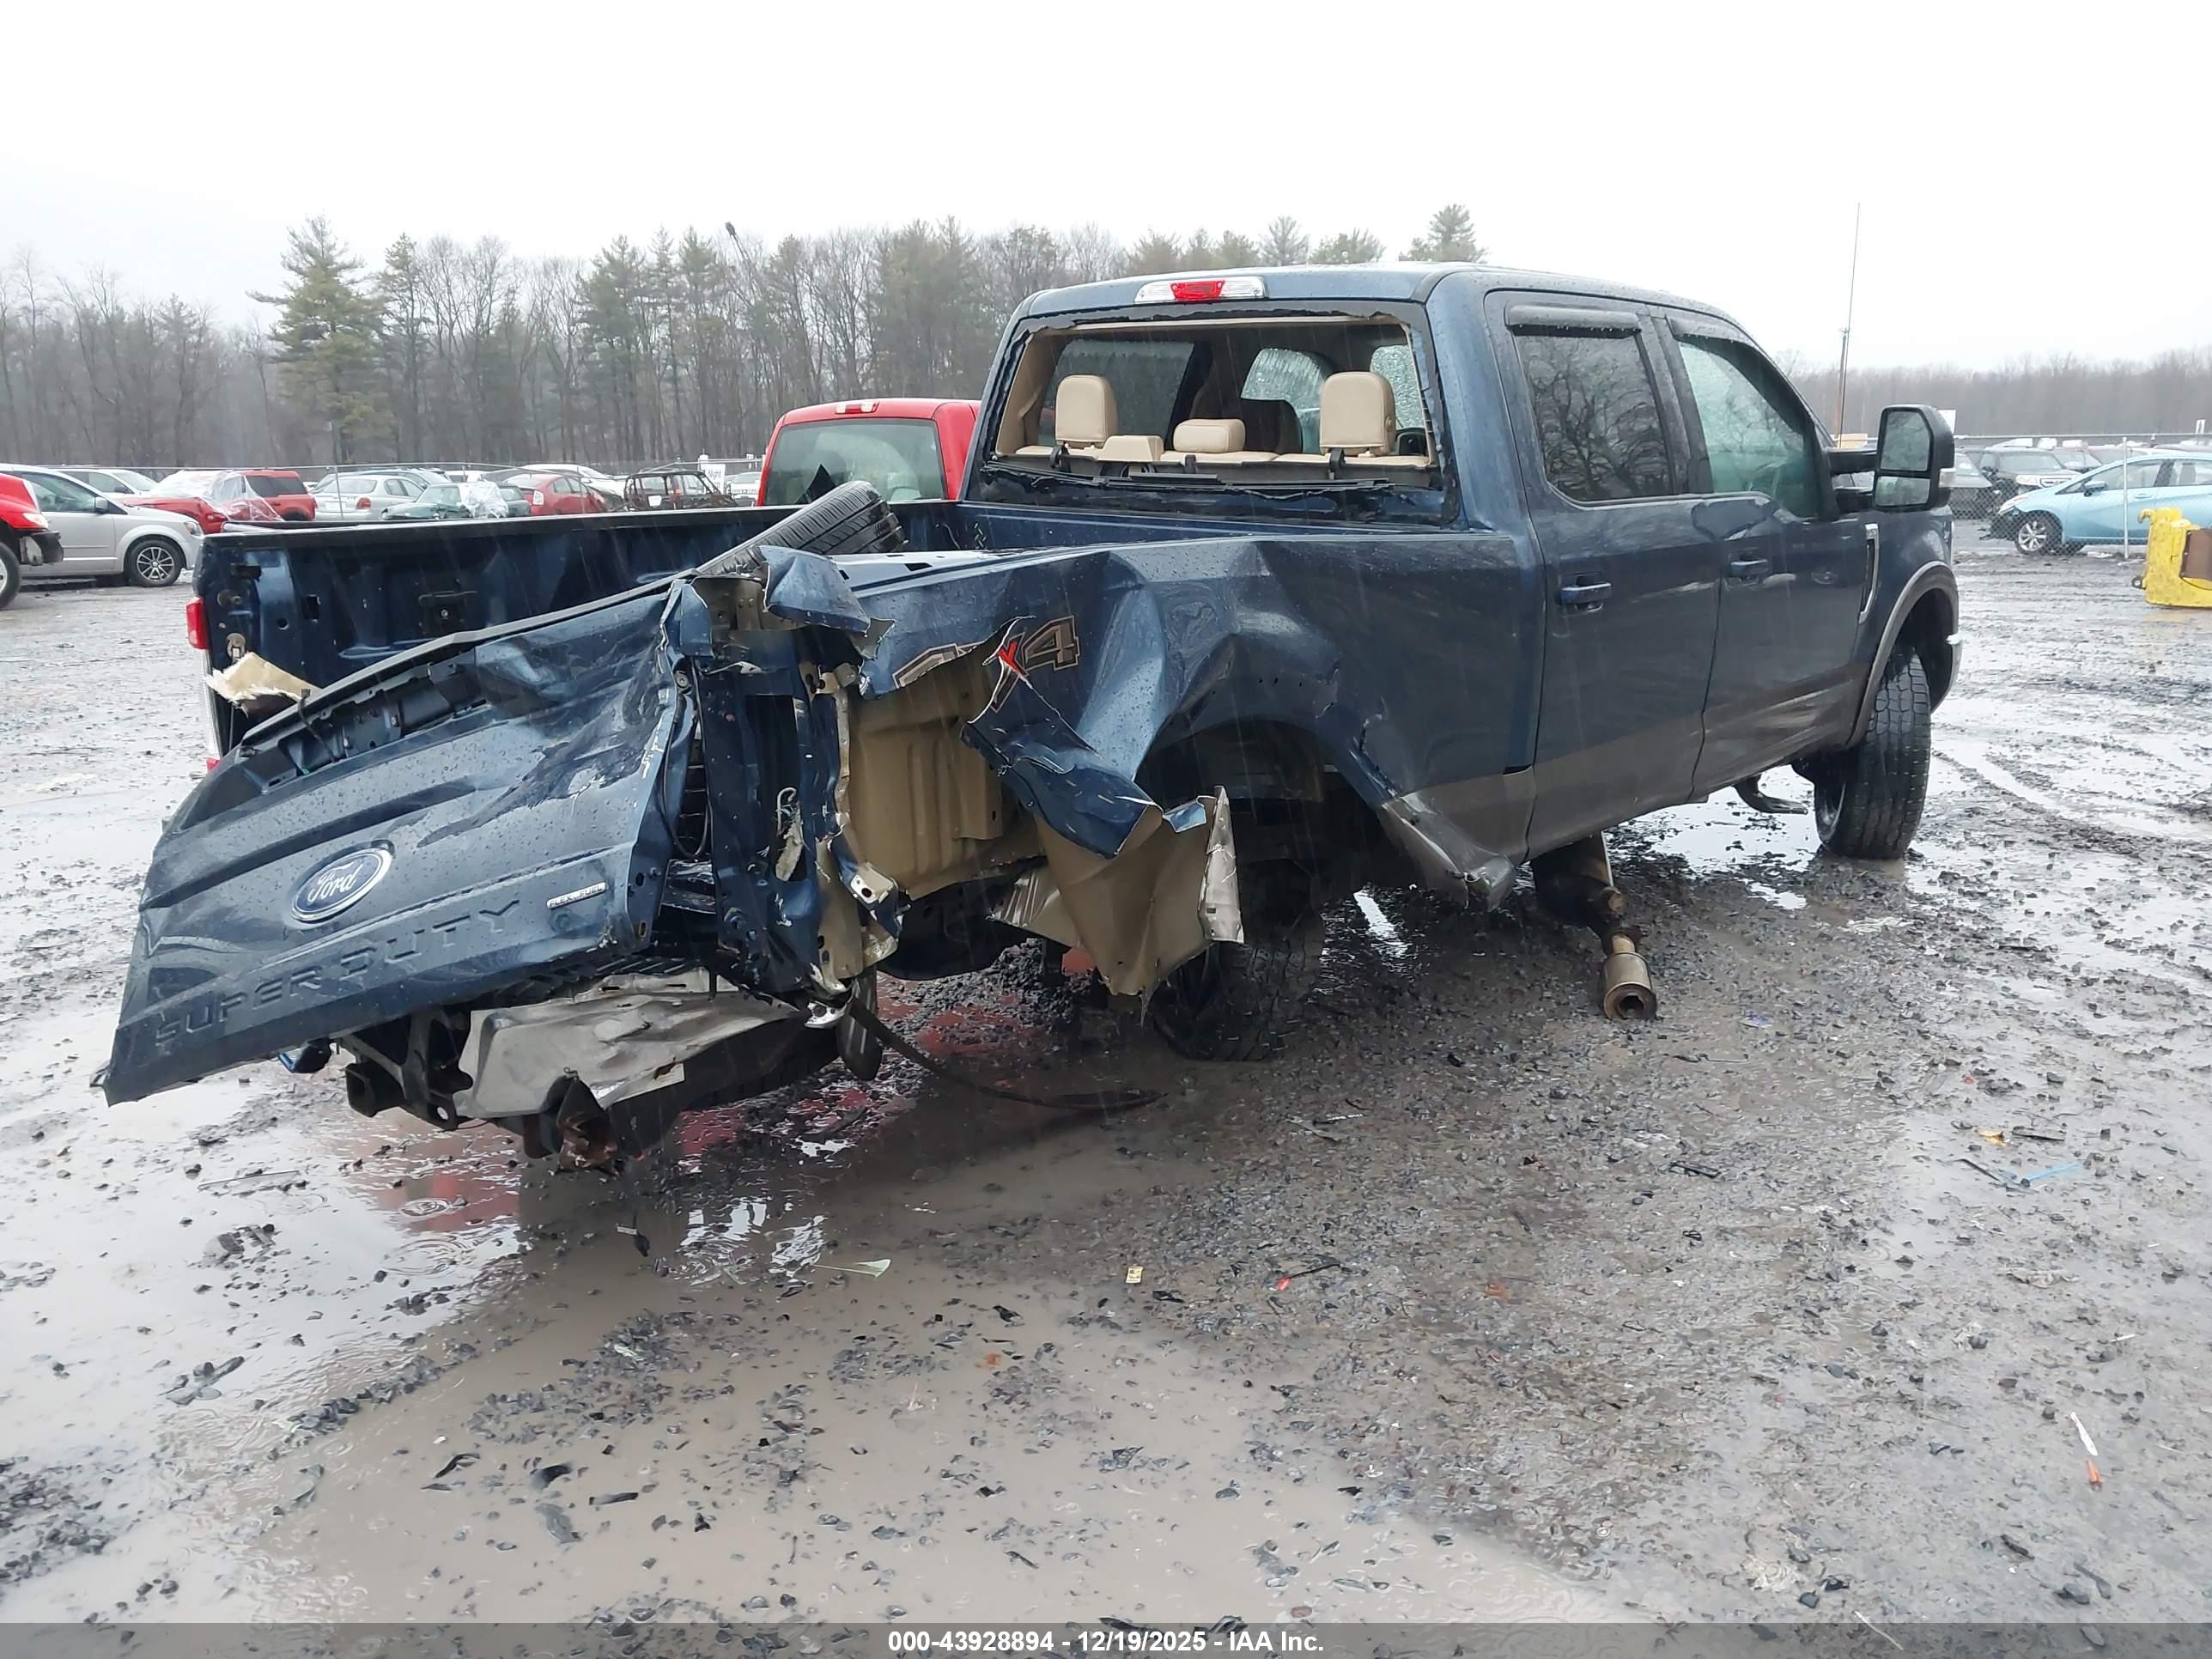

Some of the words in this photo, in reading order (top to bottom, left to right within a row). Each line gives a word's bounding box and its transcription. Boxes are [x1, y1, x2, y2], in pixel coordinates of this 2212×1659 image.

[307, 860, 364, 905] Ford
[579, 884, 604, 899] FUEL
[155, 965, 323, 1054] SUPER
[339, 899, 520, 981] DUTY
